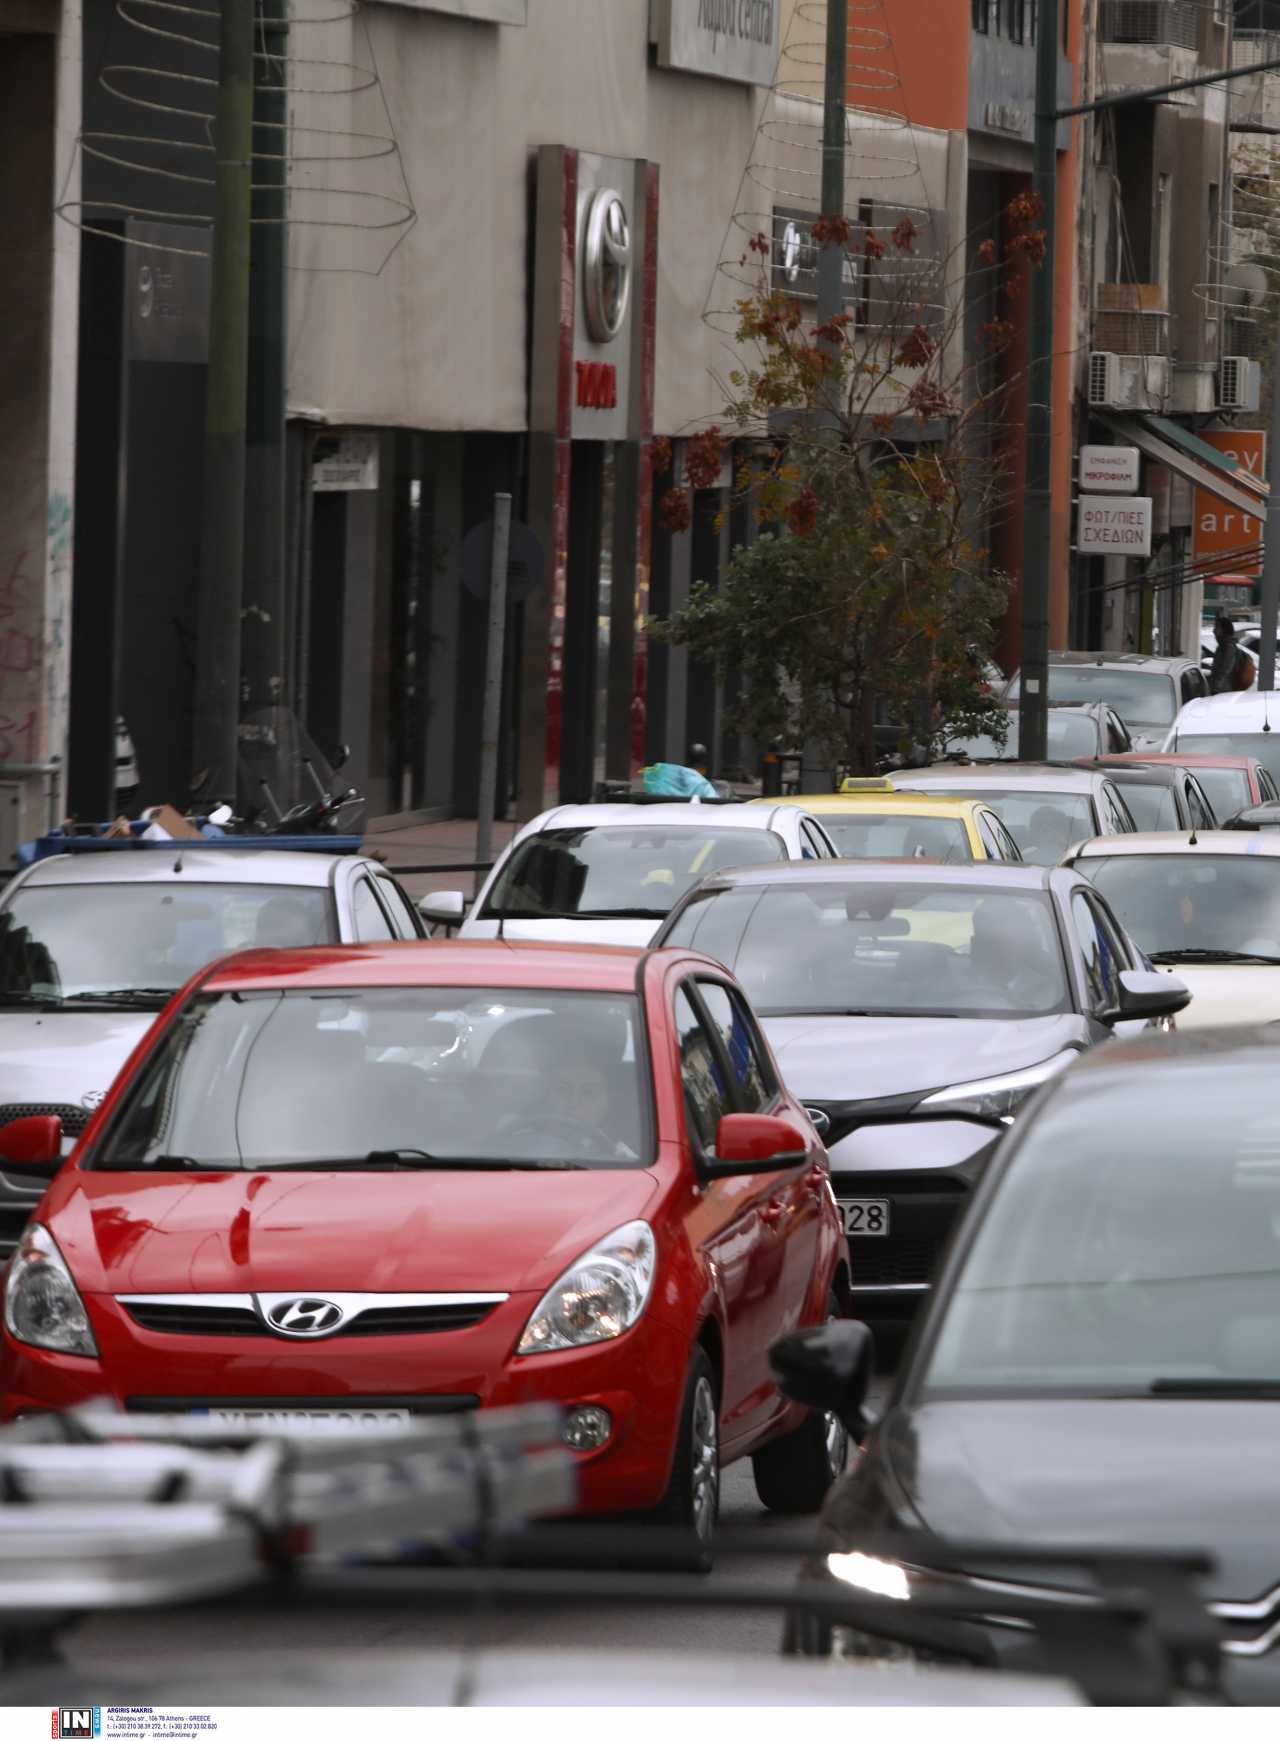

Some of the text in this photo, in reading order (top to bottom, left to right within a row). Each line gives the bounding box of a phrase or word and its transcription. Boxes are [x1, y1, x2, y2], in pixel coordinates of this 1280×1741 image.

[1083, 510, 1145, 526] ΦΩΤ/ΠΙΕΣ
[1200, 512, 1252, 533] art
[1083, 527, 1144, 544] ΣΧΕΔΙΩΝ
